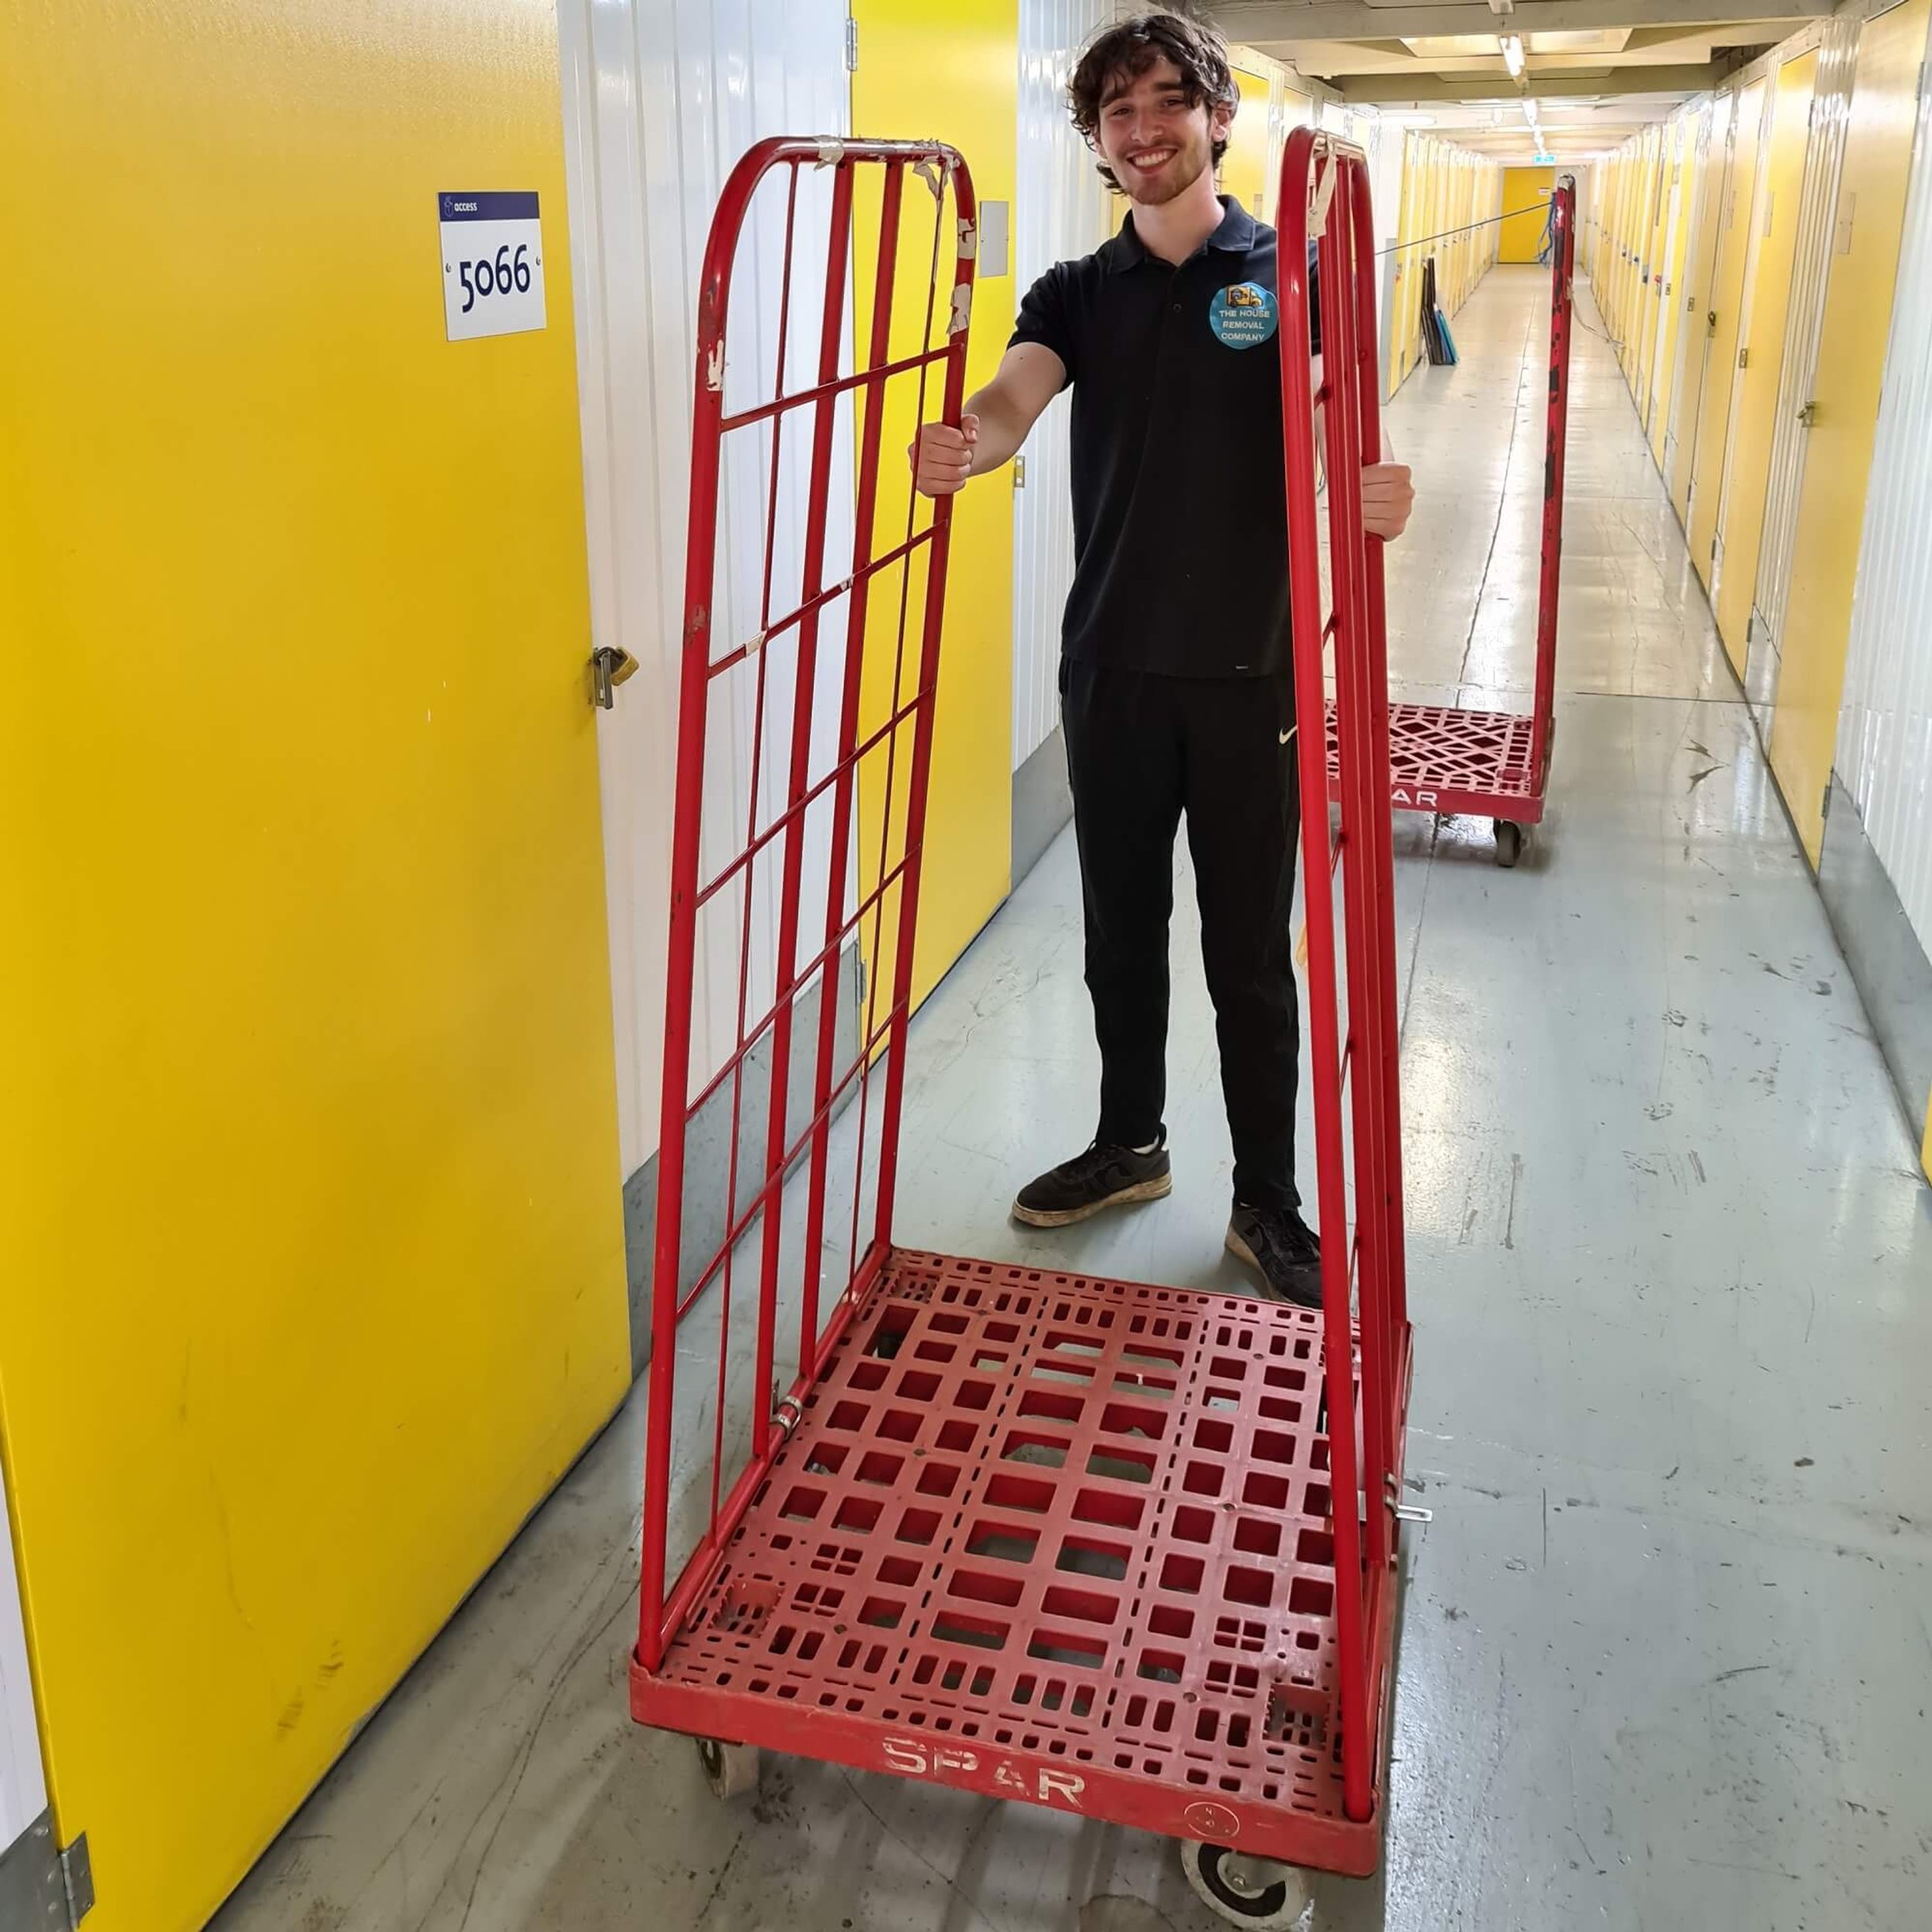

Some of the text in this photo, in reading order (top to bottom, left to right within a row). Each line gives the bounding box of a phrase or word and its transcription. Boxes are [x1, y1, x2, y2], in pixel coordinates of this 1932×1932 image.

[454, 202, 478, 213] access
[459, 243, 530, 313] 5066
[1222, 321, 1264, 329] REMOVAL
[1221, 332, 1264, 341] COMPANY
[1392, 788, 1437, 806] AR
[883, 1736, 1085, 1808] SPAR
